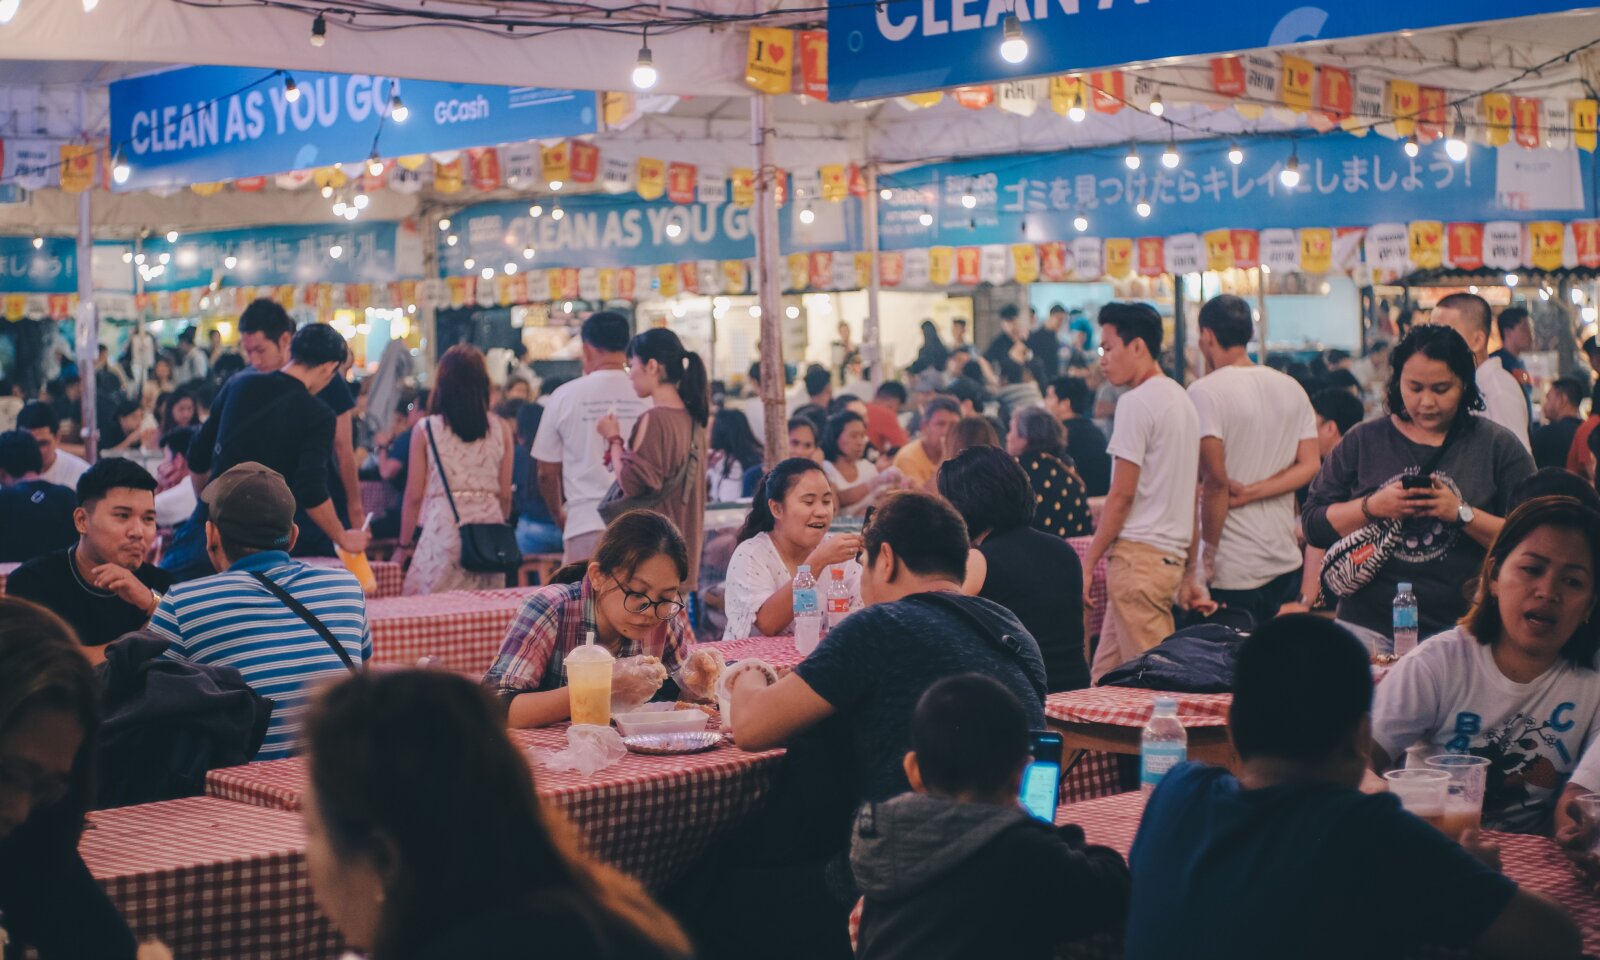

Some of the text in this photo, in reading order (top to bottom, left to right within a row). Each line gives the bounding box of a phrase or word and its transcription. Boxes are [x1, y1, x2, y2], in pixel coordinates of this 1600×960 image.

[131, 74, 400, 155] CLEAN AS YOU GO
[434, 94, 490, 125] GCash
[509, 211, 598, 251] CLEAN
[602, 208, 643, 248] AS
[646, 202, 718, 244] YOU
[723, 203, 757, 241] G
